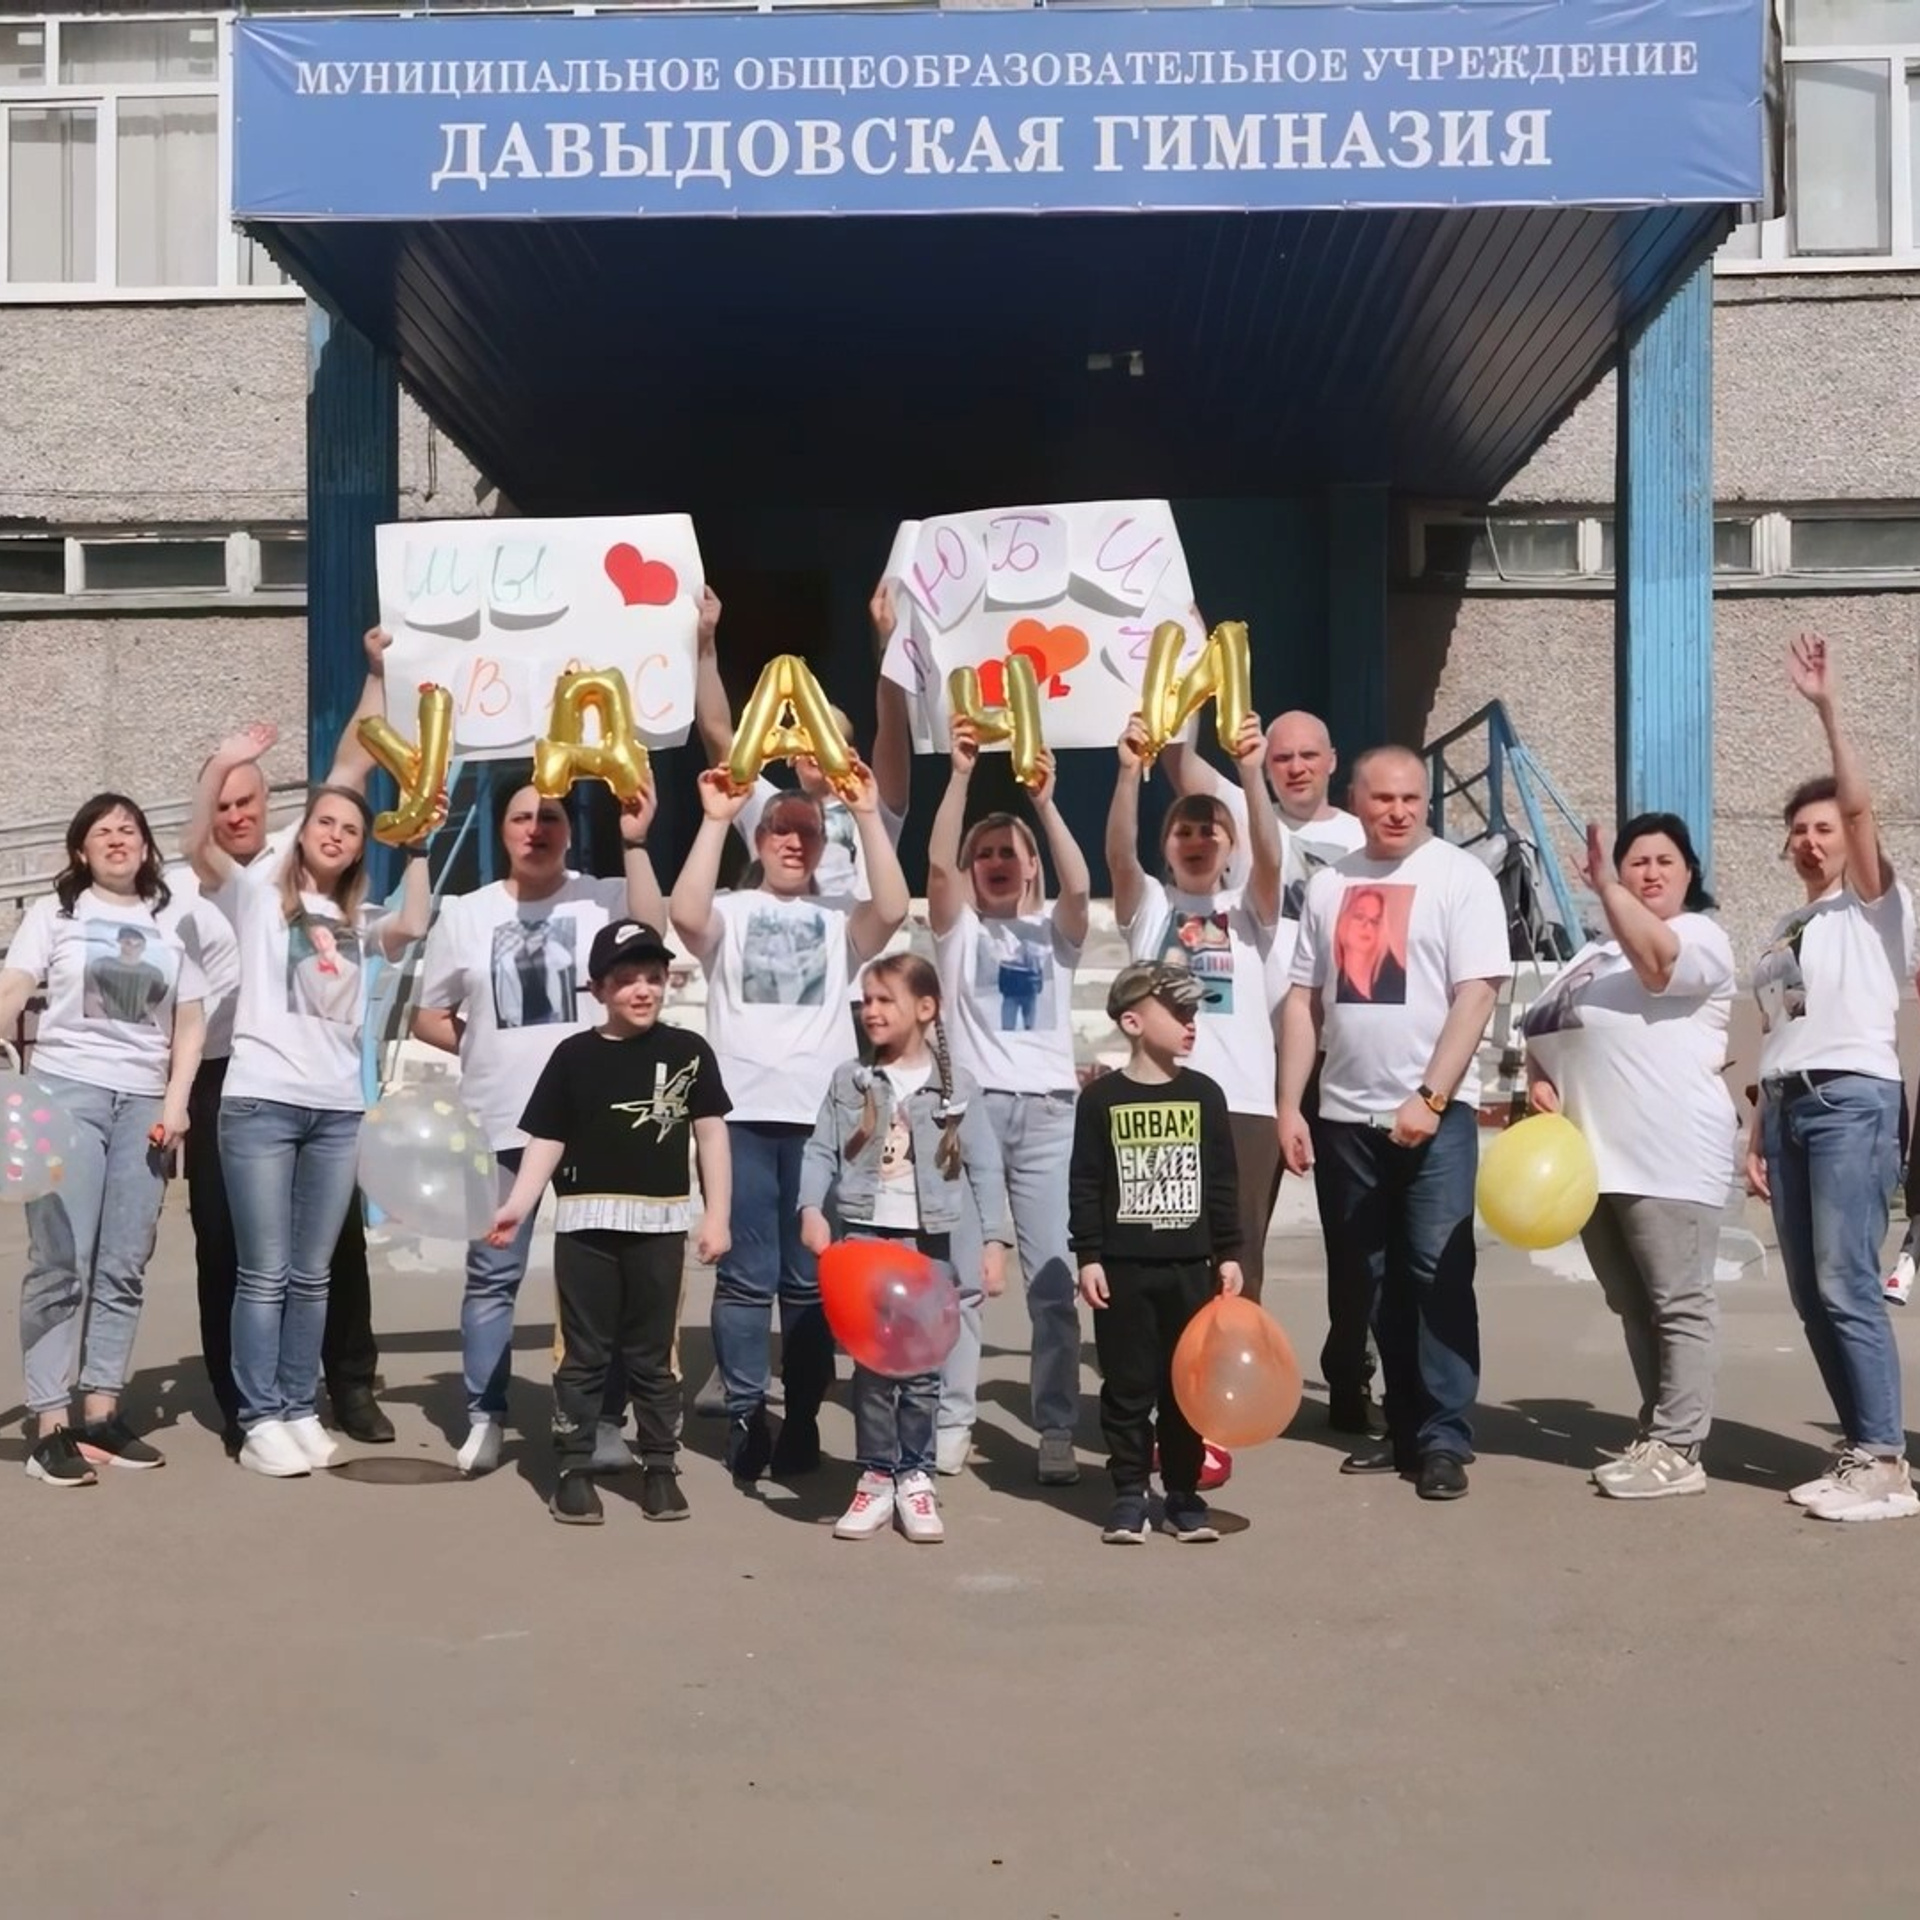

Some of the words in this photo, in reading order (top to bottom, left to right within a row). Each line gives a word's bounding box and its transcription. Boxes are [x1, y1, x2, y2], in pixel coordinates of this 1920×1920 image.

[296, 57, 720, 99] МУНИЦИПАЛЬНОЕ
[734, 48, 1347, 95] ОБЩЕОБРАЗОВАТЕЛЬНОЕ
[1363, 41, 1698, 83] УЧРЕЖДЕНИЕ
[431, 116, 1064, 191] ДАВЫДОВСКАЯ
[1093, 109, 1553, 171] ГИМНАЗИЯ
[458, 654, 674, 722] ВС
[1117, 1109, 1194, 1139] URBAN
